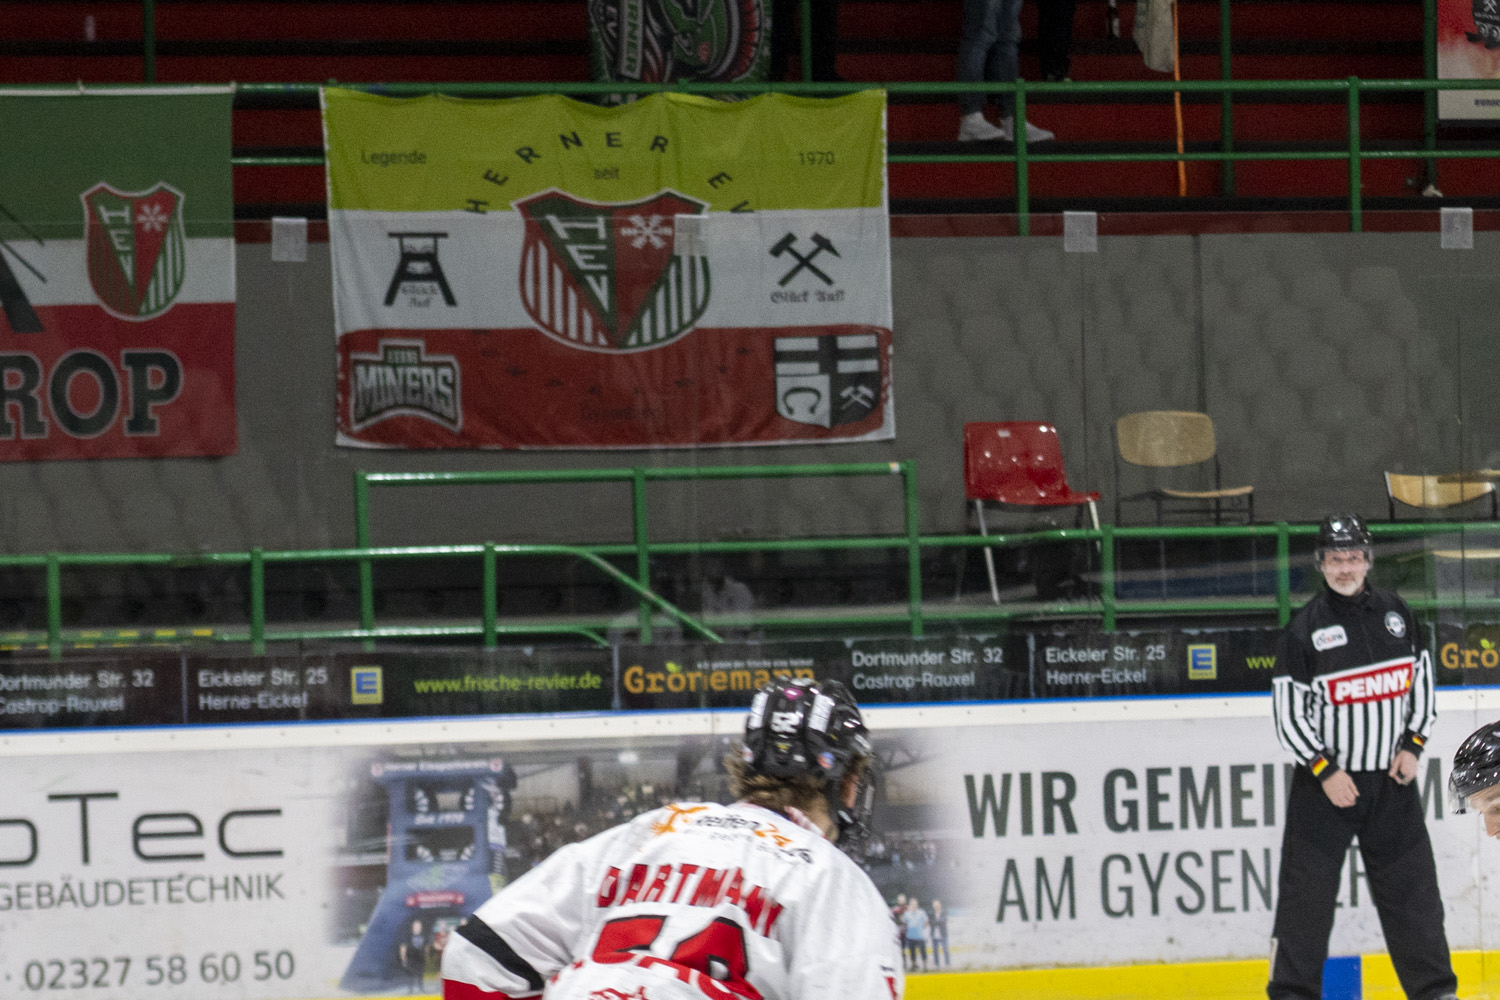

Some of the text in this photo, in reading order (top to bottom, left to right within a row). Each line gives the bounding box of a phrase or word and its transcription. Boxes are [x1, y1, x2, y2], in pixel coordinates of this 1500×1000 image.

[360, 148, 427, 168] Legende
[798, 150, 836, 168] 1970
[594, 166, 620, 181] seit
[355, 365, 456, 421] MINERS
[852, 648, 1004, 668] Dortmunder Str. 32
[1046, 644, 1166, 664] Eickeler Str. 25
[133, 669, 154, 688] 32
[198, 670, 265, 688] Eickeler
[306, 667, 328, 686] 25
[414, 672, 602, 694] www.frische-revier.de
[853, 672, 976, 690] Castrop-Rauxel
[1046, 666, 1147, 685] Herne-Eickel
[964, 757, 1444, 838] WIR GEMEIM
[996, 847, 1376, 922] AM GYSEN
[24, 949, 296, 991] 02327 58 60 50
